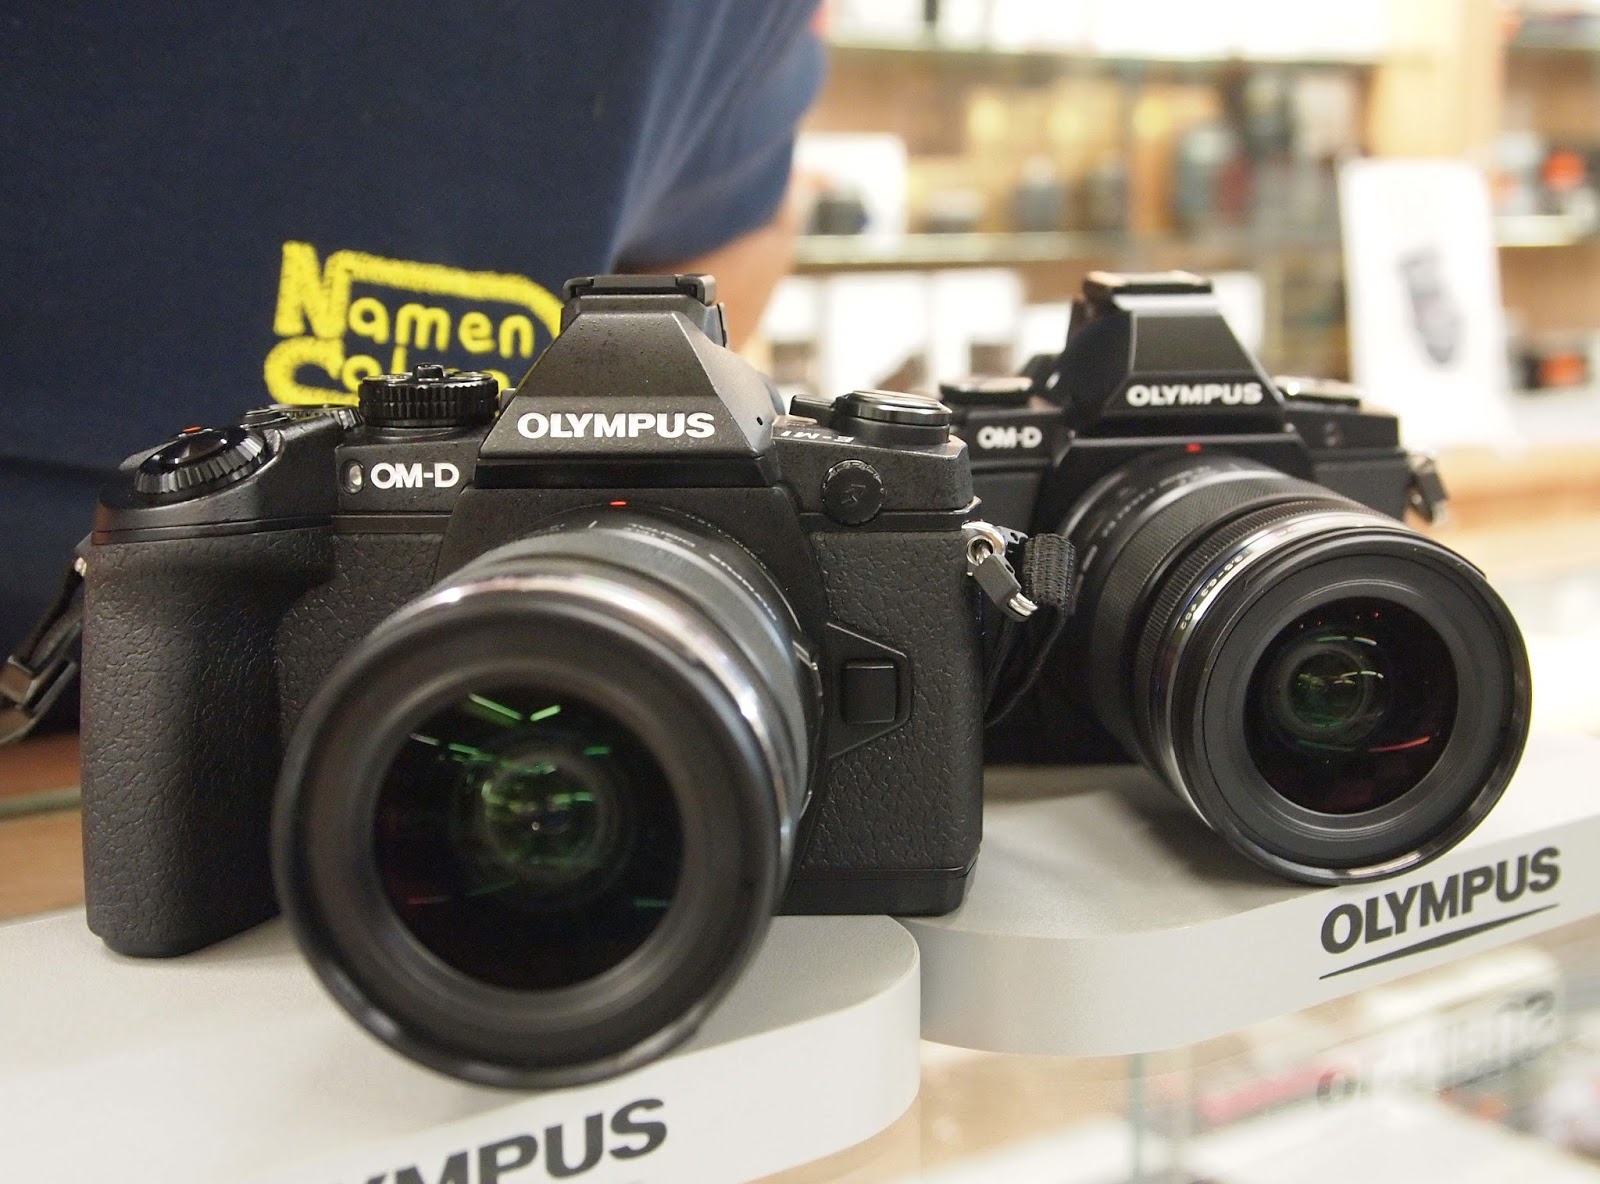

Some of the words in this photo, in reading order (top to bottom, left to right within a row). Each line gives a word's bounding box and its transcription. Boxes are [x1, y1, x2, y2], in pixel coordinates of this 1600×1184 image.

[274, 241, 564, 359] Namen
[1126, 381, 1264, 408] OLYMPUS
[516, 411, 716, 440] OLYMPUS
[976, 424, 1042, 450] OM-D
[370, 462, 460, 488] OM-D
[1320, 846, 1561, 955] OLYMPUS
